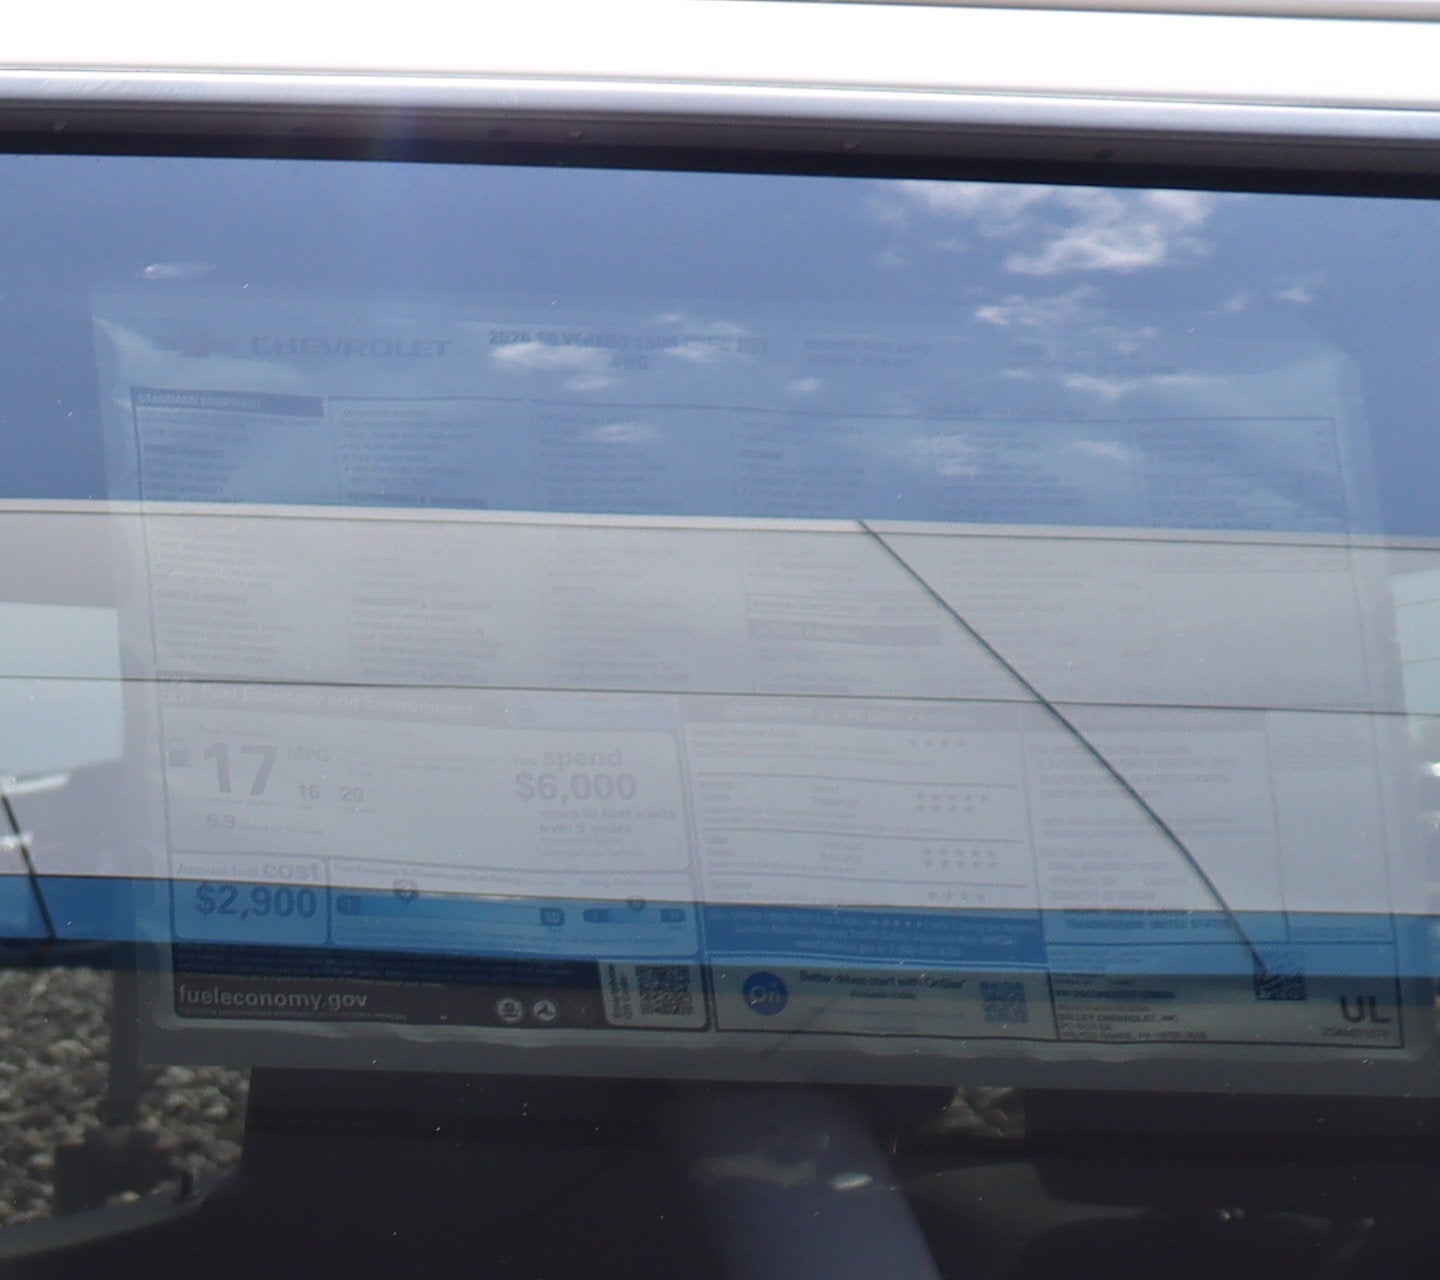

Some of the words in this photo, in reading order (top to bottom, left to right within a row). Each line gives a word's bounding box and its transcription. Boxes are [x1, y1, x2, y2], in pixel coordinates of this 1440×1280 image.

[251, 336, 452, 358] CHEVROLET
[203, 742, 278, 797] 17
[286, 745, 330, 763] MPG
[543, 748, 622, 770] spend
[297, 784, 321, 801] 16
[340, 785, 365, 803] 20
[515, 769, 637, 804] $6,000
[262, 862, 323, 880] cost
[195, 881, 317, 920] $2,900
[179, 984, 368, 1011] fueleconomy.gov
[749, 984, 782, 1006] On
[1339, 995, 1391, 1023] UL
